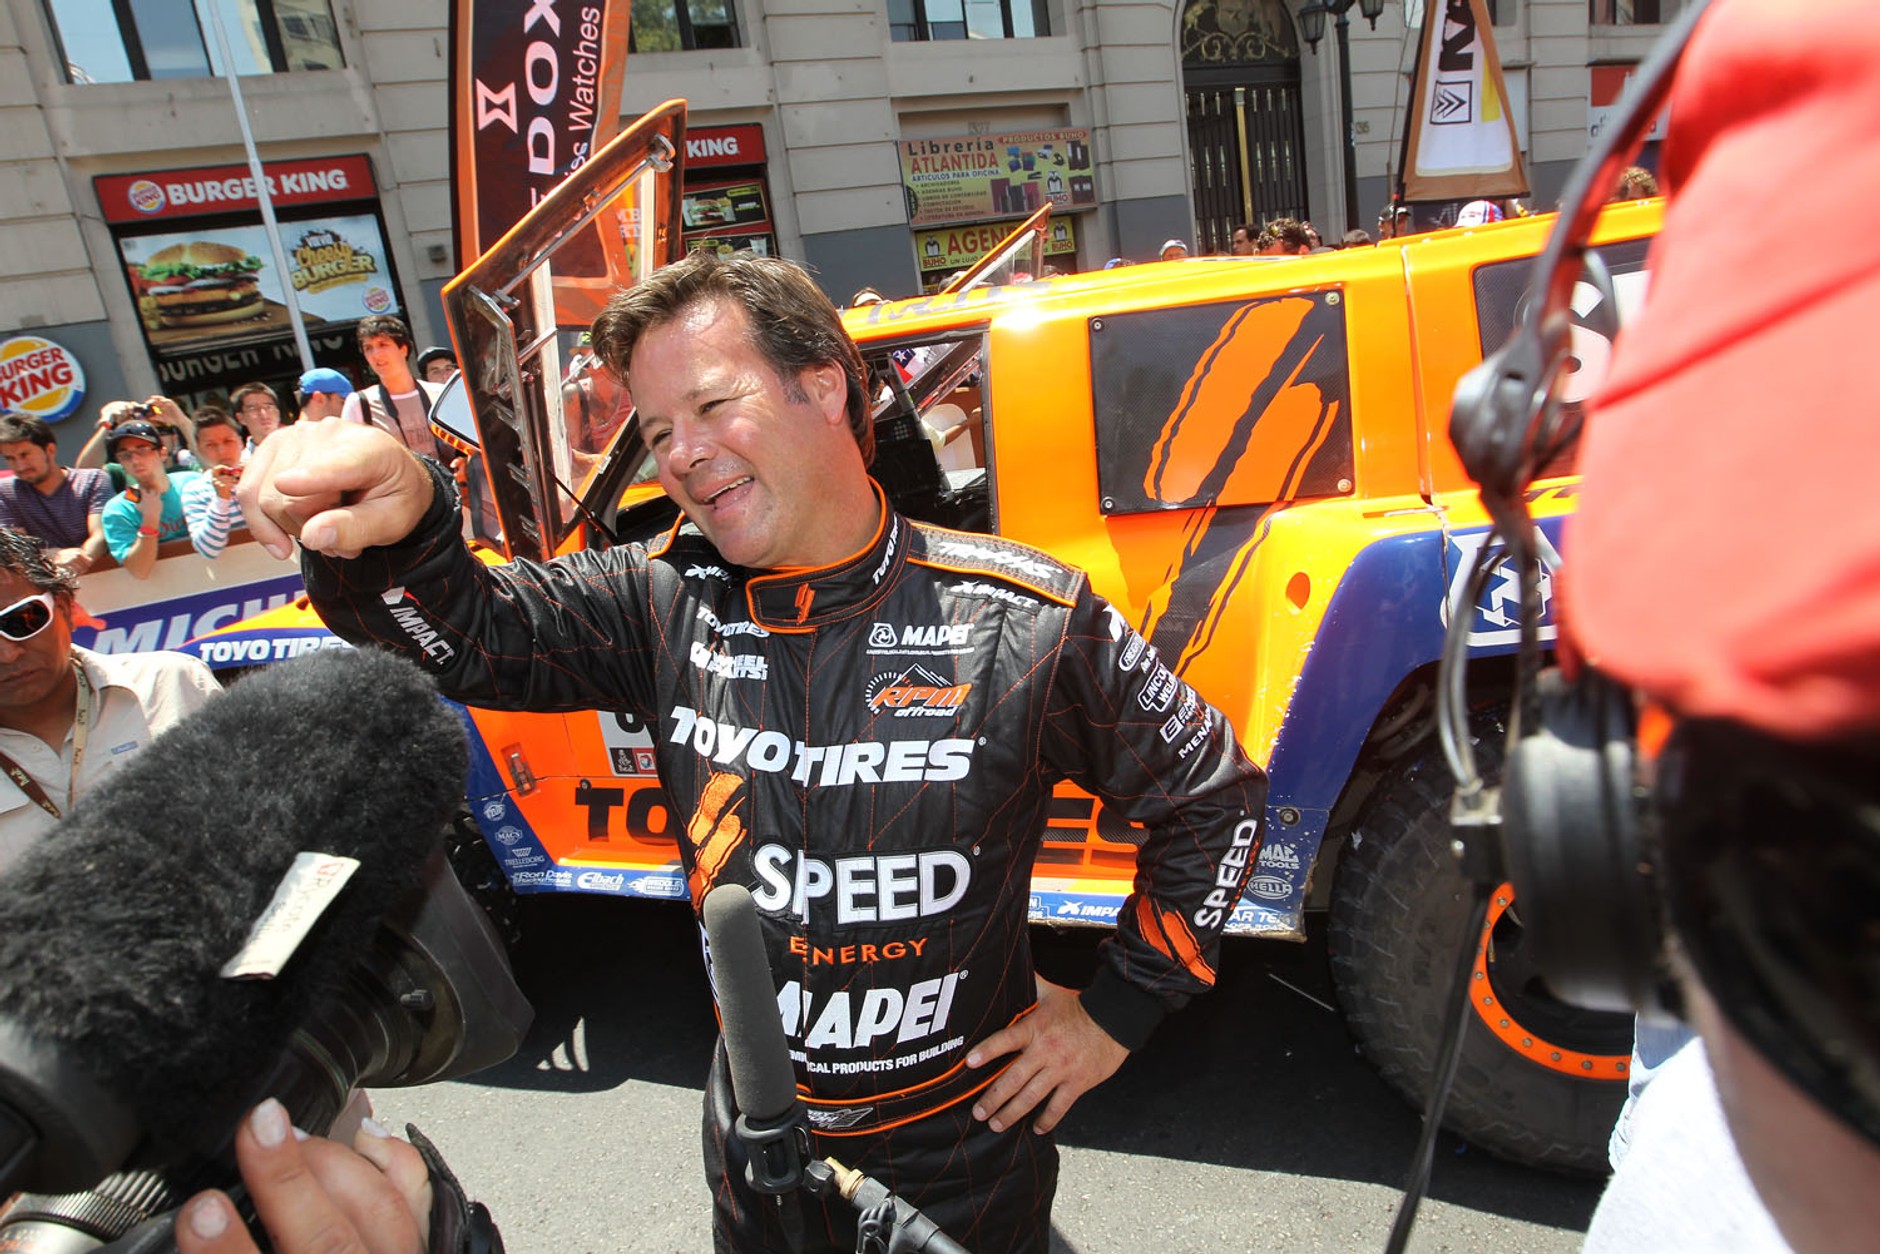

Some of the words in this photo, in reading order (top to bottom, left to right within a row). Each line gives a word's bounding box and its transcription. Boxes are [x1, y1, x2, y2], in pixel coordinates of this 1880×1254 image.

[568, 6, 601, 131] Watches
[686, 137, 739, 158] KING
[908, 137, 995, 156] Librería
[1002, 133, 1057, 144] PRODUCTOS
[1059, 131, 1085, 140] BUHO
[911, 152, 999, 174] ATLANTIDA
[972, 169, 999, 177] OFICINA
[166, 177, 278, 205] BURGER
[280, 169, 347, 194] KING
[948, 227, 1006, 255] AGEN
[1052, 241, 1073, 250] BUHO
[292, 255, 376, 290] BURGER
[923, 257, 946, 267] BUHO
[0, 347, 64, 382] URGER
[0, 362, 73, 409] KING
[391, 607, 455, 665] IMPACT
[901, 625, 970, 646] MAPEI
[868, 683, 974, 708] RPM
[894, 706, 959, 717] offroad
[575, 787, 678, 846] TO
[1194, 819, 1257, 930] SPEED
[1260, 861, 1299, 870] TOOLS
[752, 844, 971, 925] SPEED
[1250, 881, 1293, 895] HELLA
[1080, 905, 1121, 917] IMPA
[789, 937, 928, 966] ENERGY
[832, 1058, 894, 1074] PRODUCTS
[896, 1053, 918, 1069] FOR
[918, 1036, 964, 1063] BUILDING
